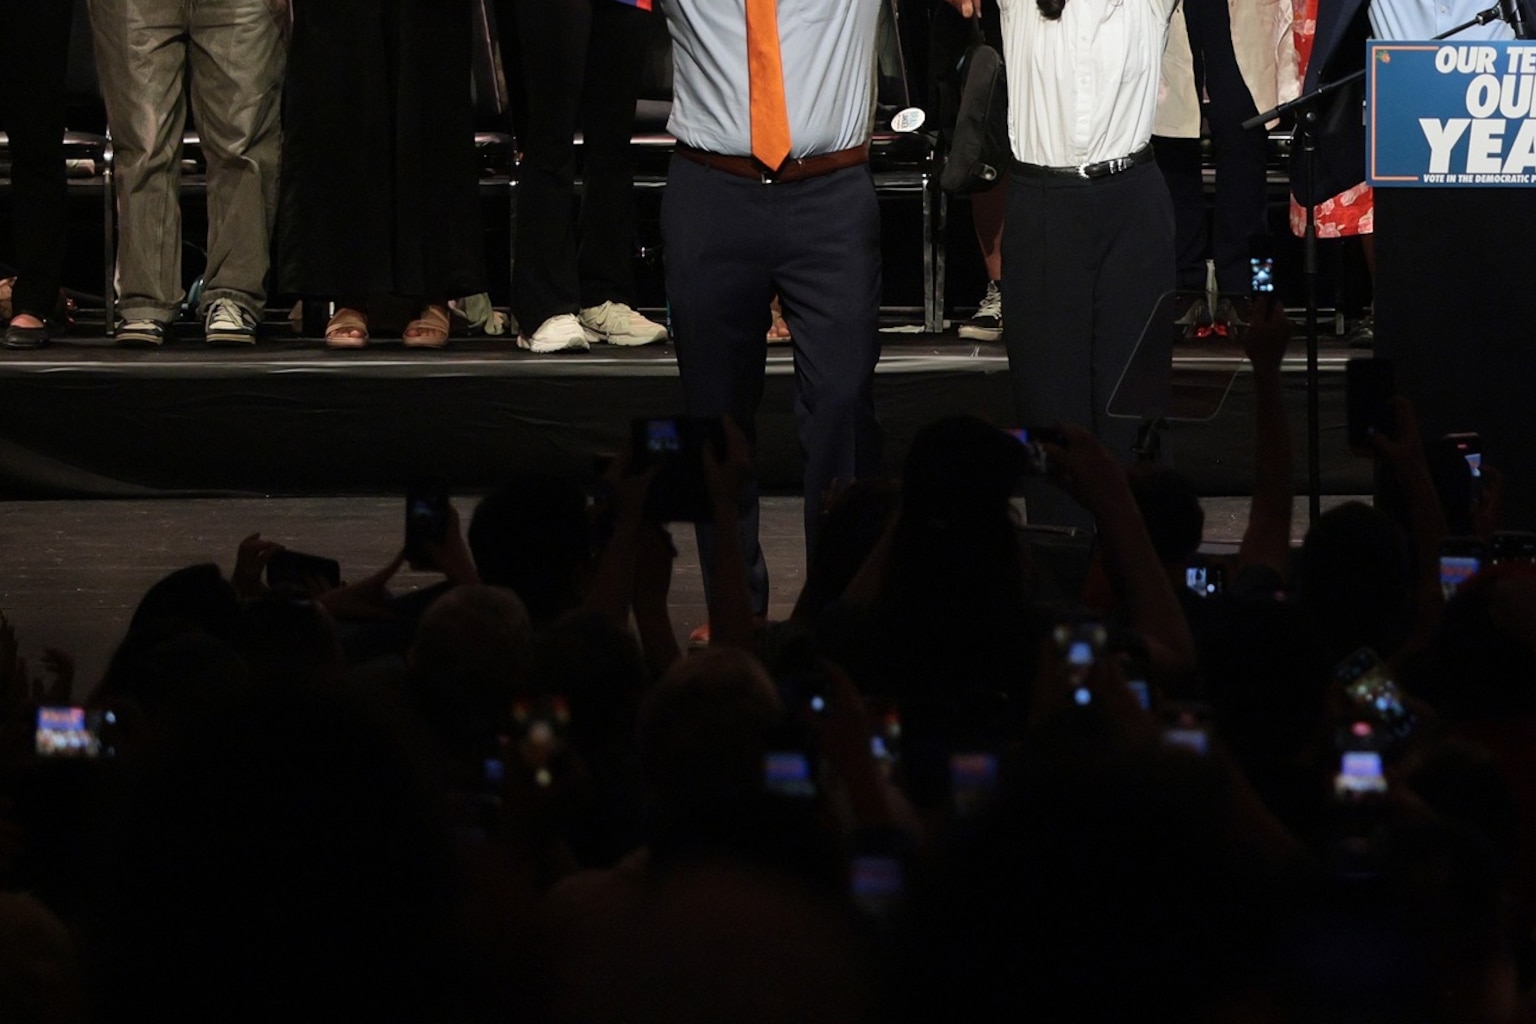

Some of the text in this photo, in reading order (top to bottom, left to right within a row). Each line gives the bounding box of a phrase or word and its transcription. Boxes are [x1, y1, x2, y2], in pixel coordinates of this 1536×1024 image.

[1435, 46, 1497, 73] OUR
[1423, 174, 1444, 184] VOTE
[1446, 174, 1456, 183] IN
[1458, 174, 1474, 183] THE
[1475, 174, 1529, 183] DEMOCRATIC
